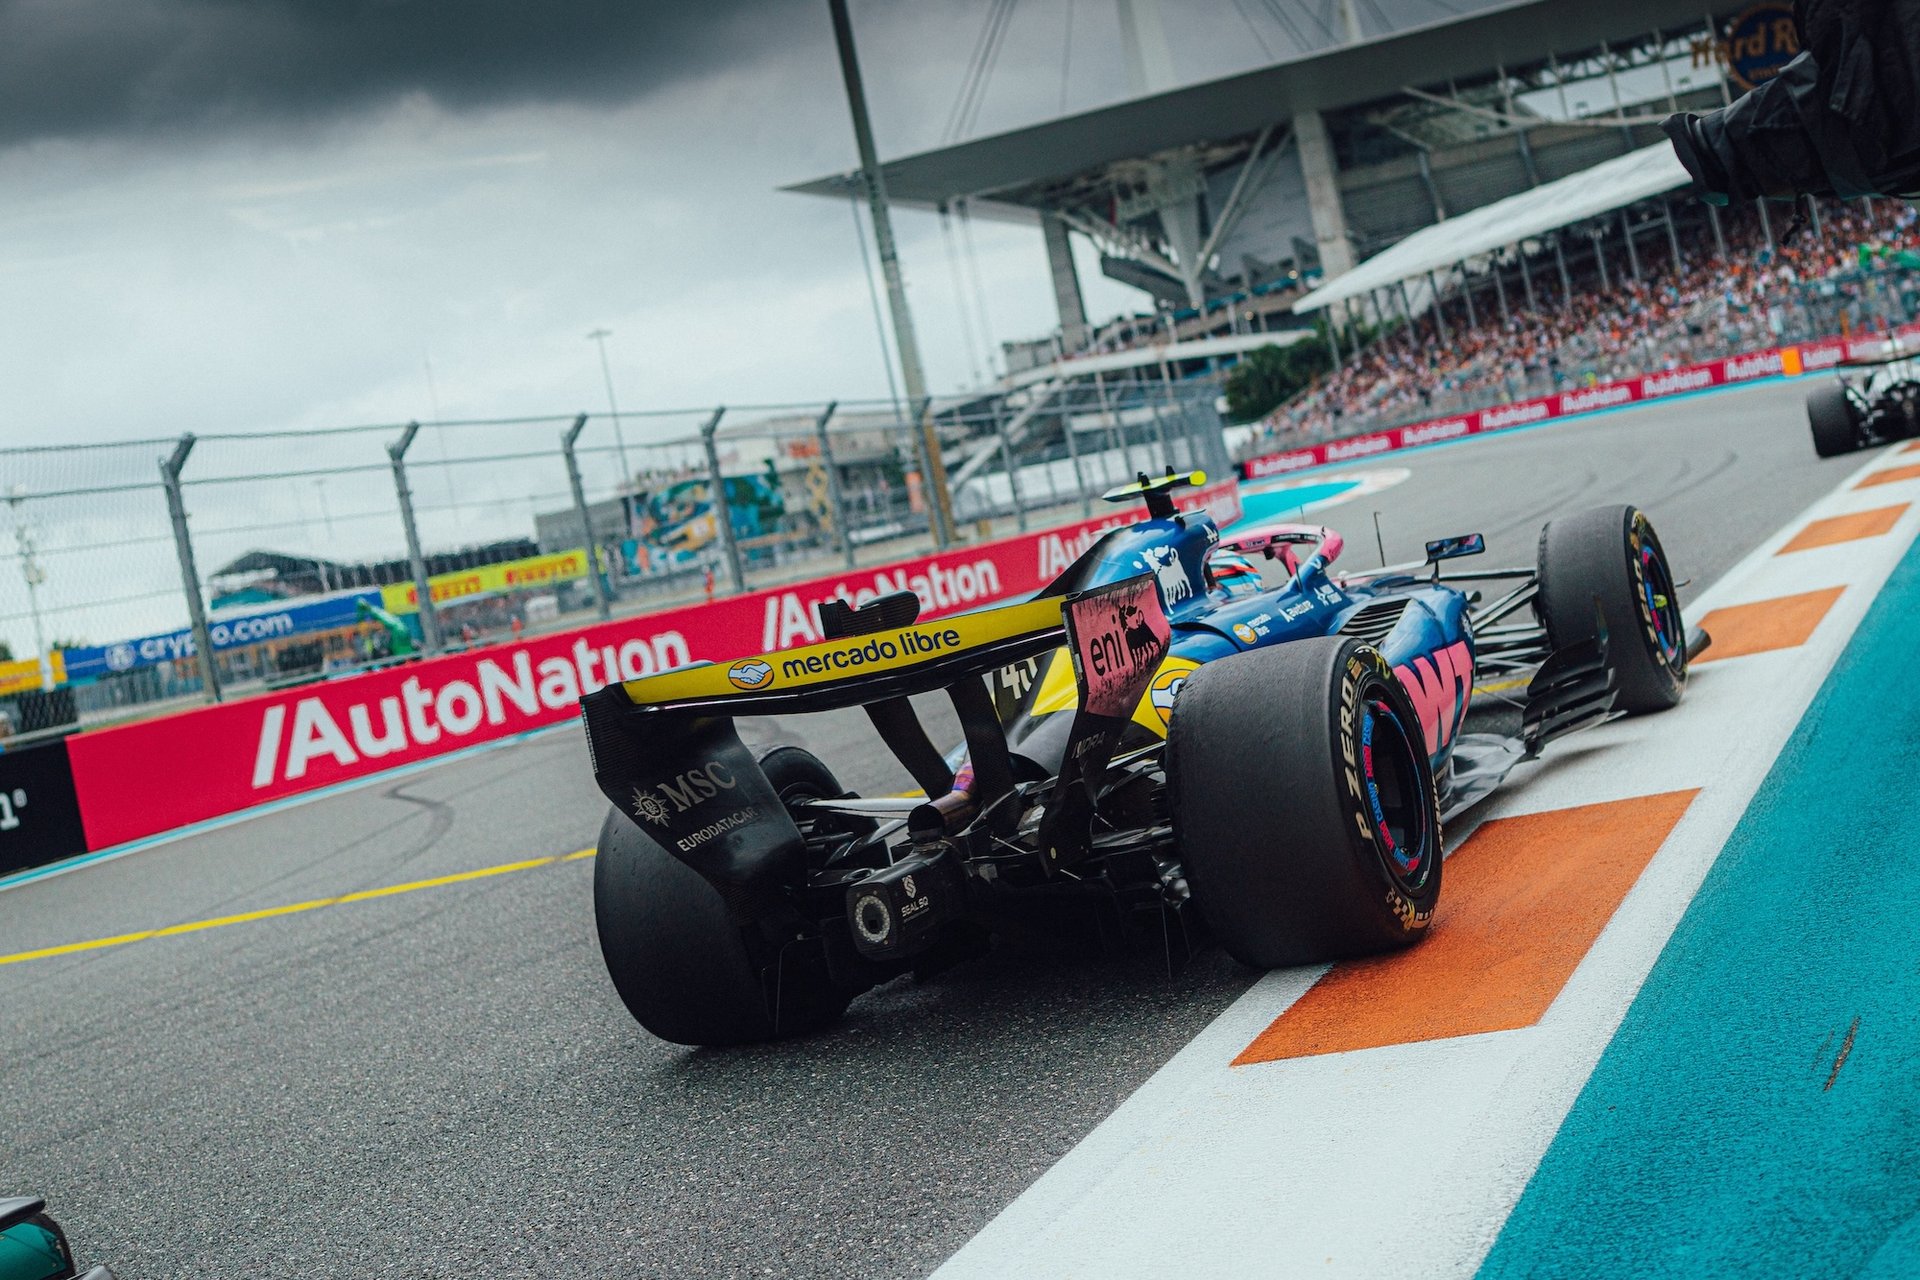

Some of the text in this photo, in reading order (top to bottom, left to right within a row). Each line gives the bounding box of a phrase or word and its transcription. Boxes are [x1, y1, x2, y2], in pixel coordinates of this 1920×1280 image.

[140, 613, 294, 659] crypo.com
[782, 628, 961, 679] mercado libre
[1090, 614, 1126, 676] eni
[1340, 675, 1362, 801] ZERO
[656, 761, 737, 813] MSC
[676, 806, 759, 852] EURODATACAR
